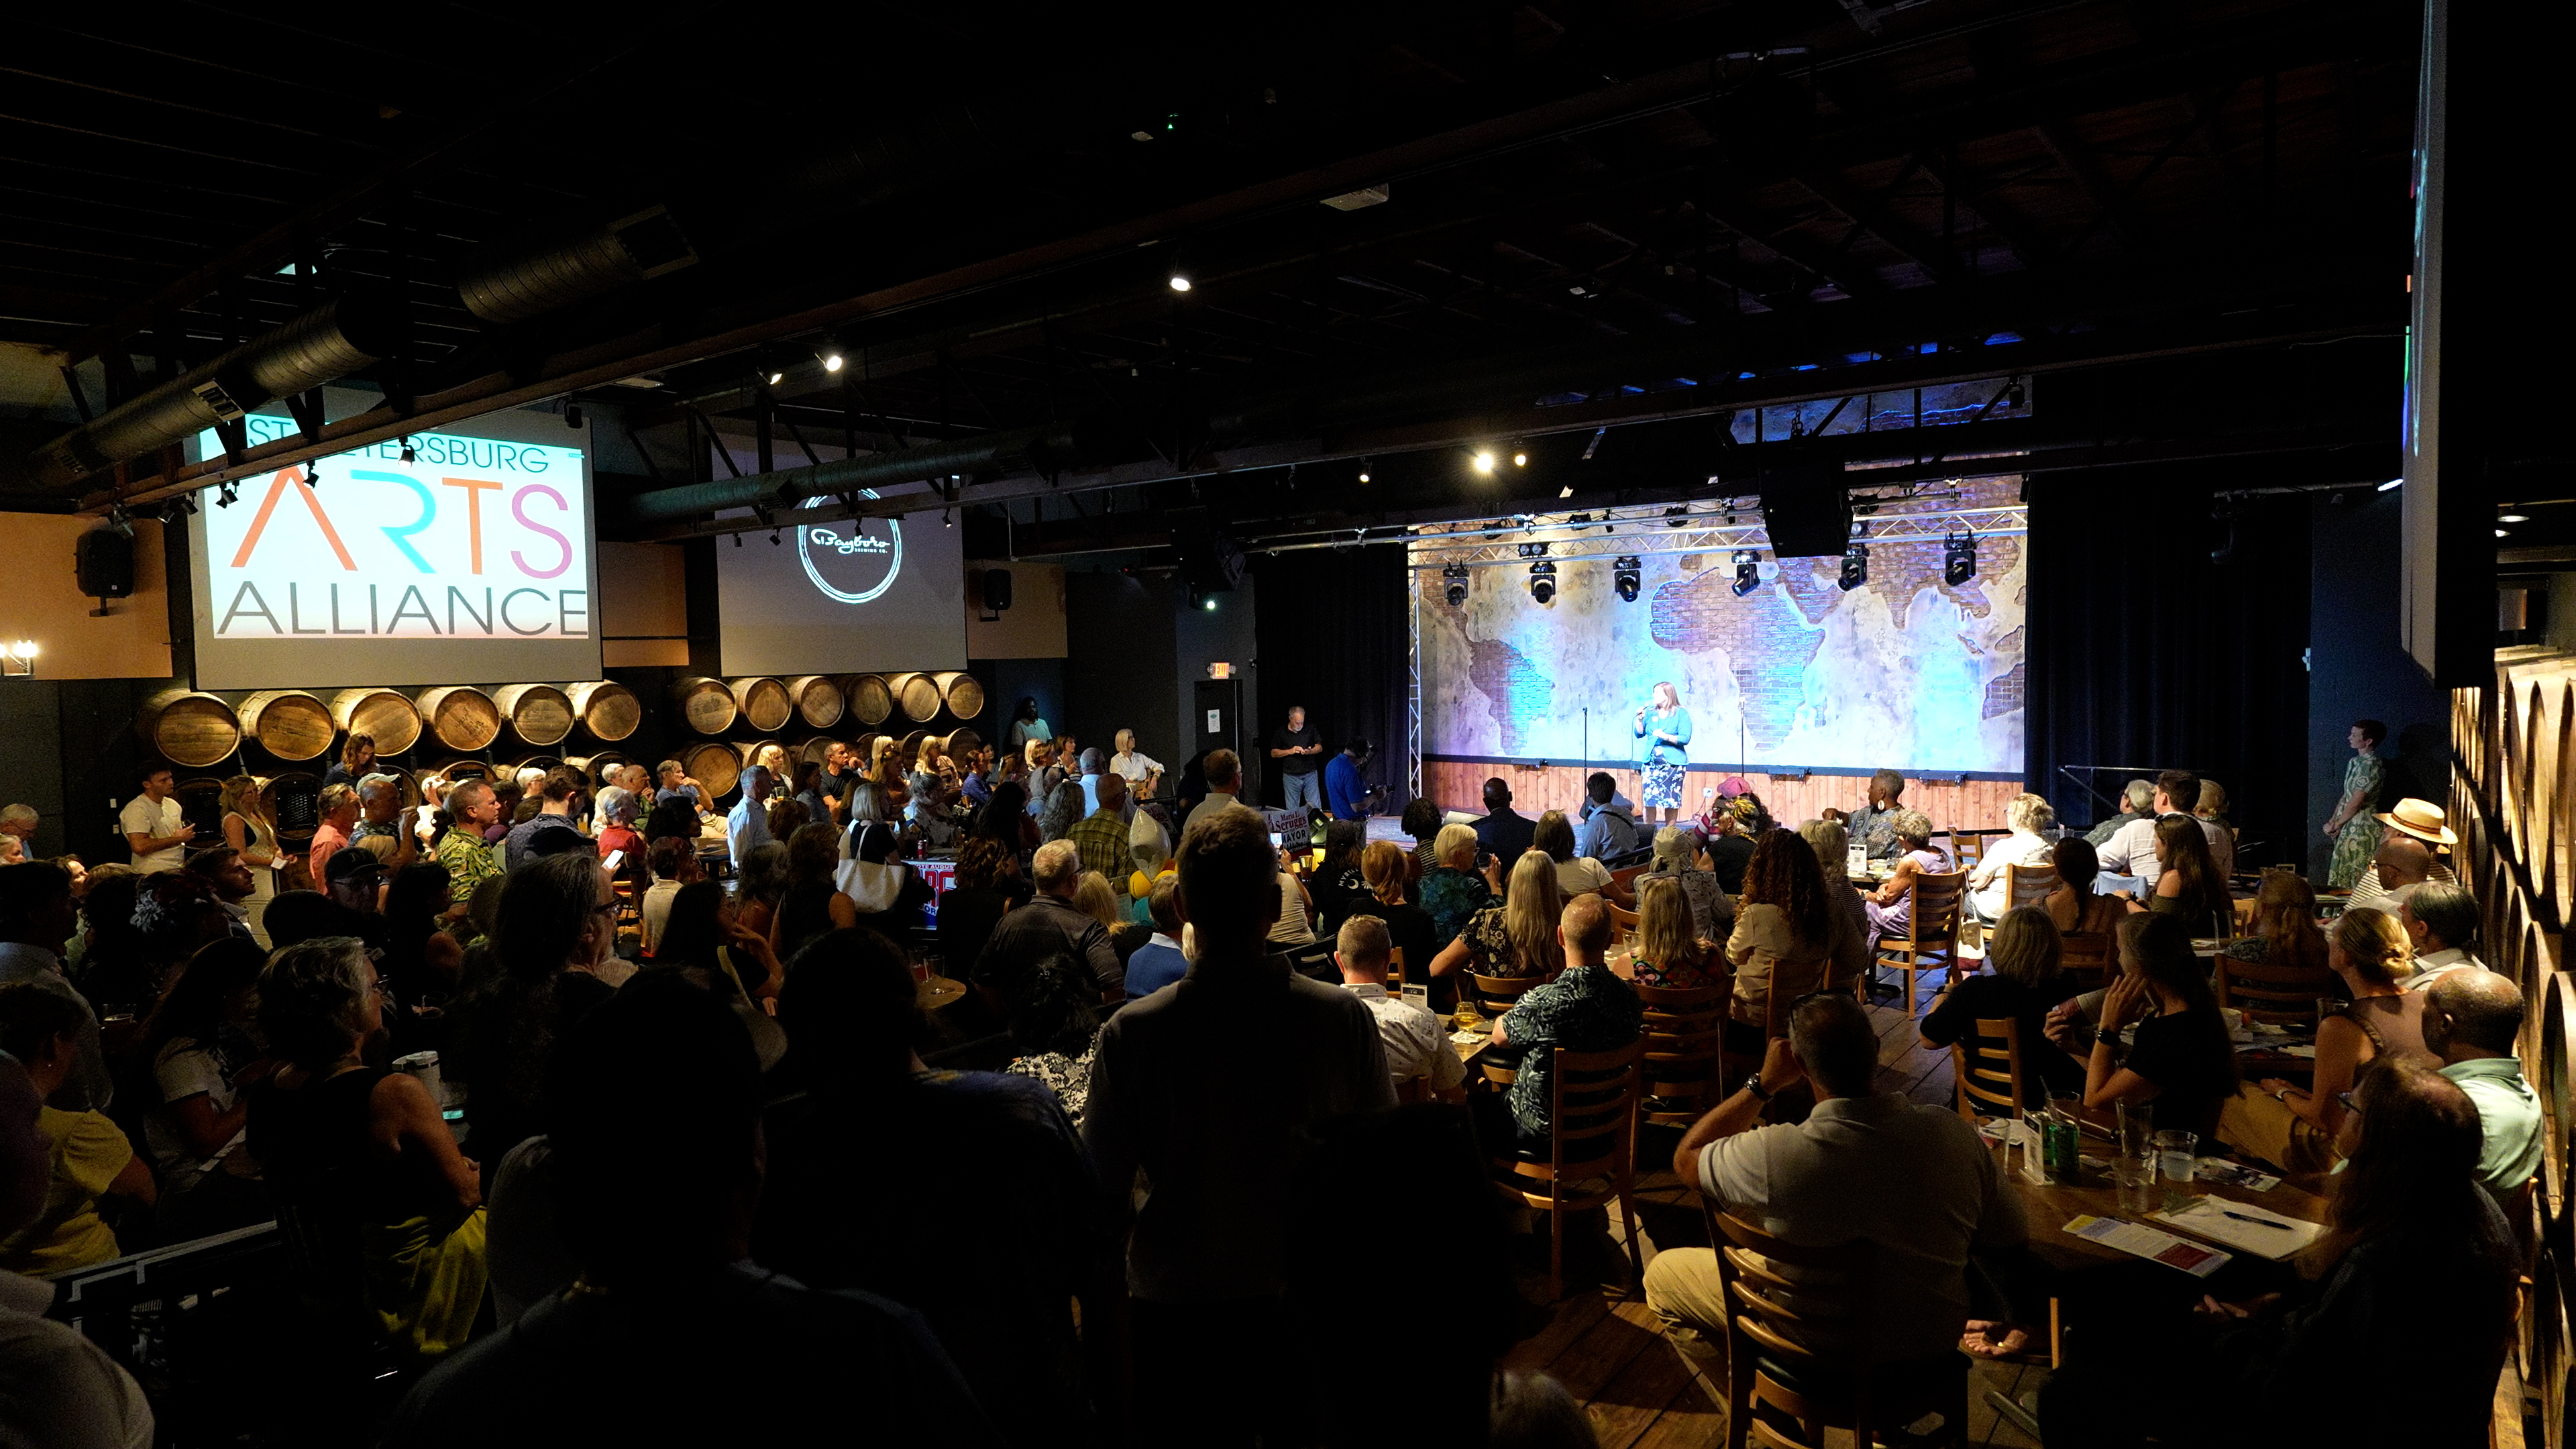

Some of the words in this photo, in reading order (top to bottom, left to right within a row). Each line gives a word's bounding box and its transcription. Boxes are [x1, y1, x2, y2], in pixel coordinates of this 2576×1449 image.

[230, 465, 573, 579] ARTS
[810, 528, 891, 554] Bayboro
[217, 580, 587, 635] ALLIANCE
[1215, 663, 1228, 677] EXIT
[1275, 816, 1307, 831] Scruggs
